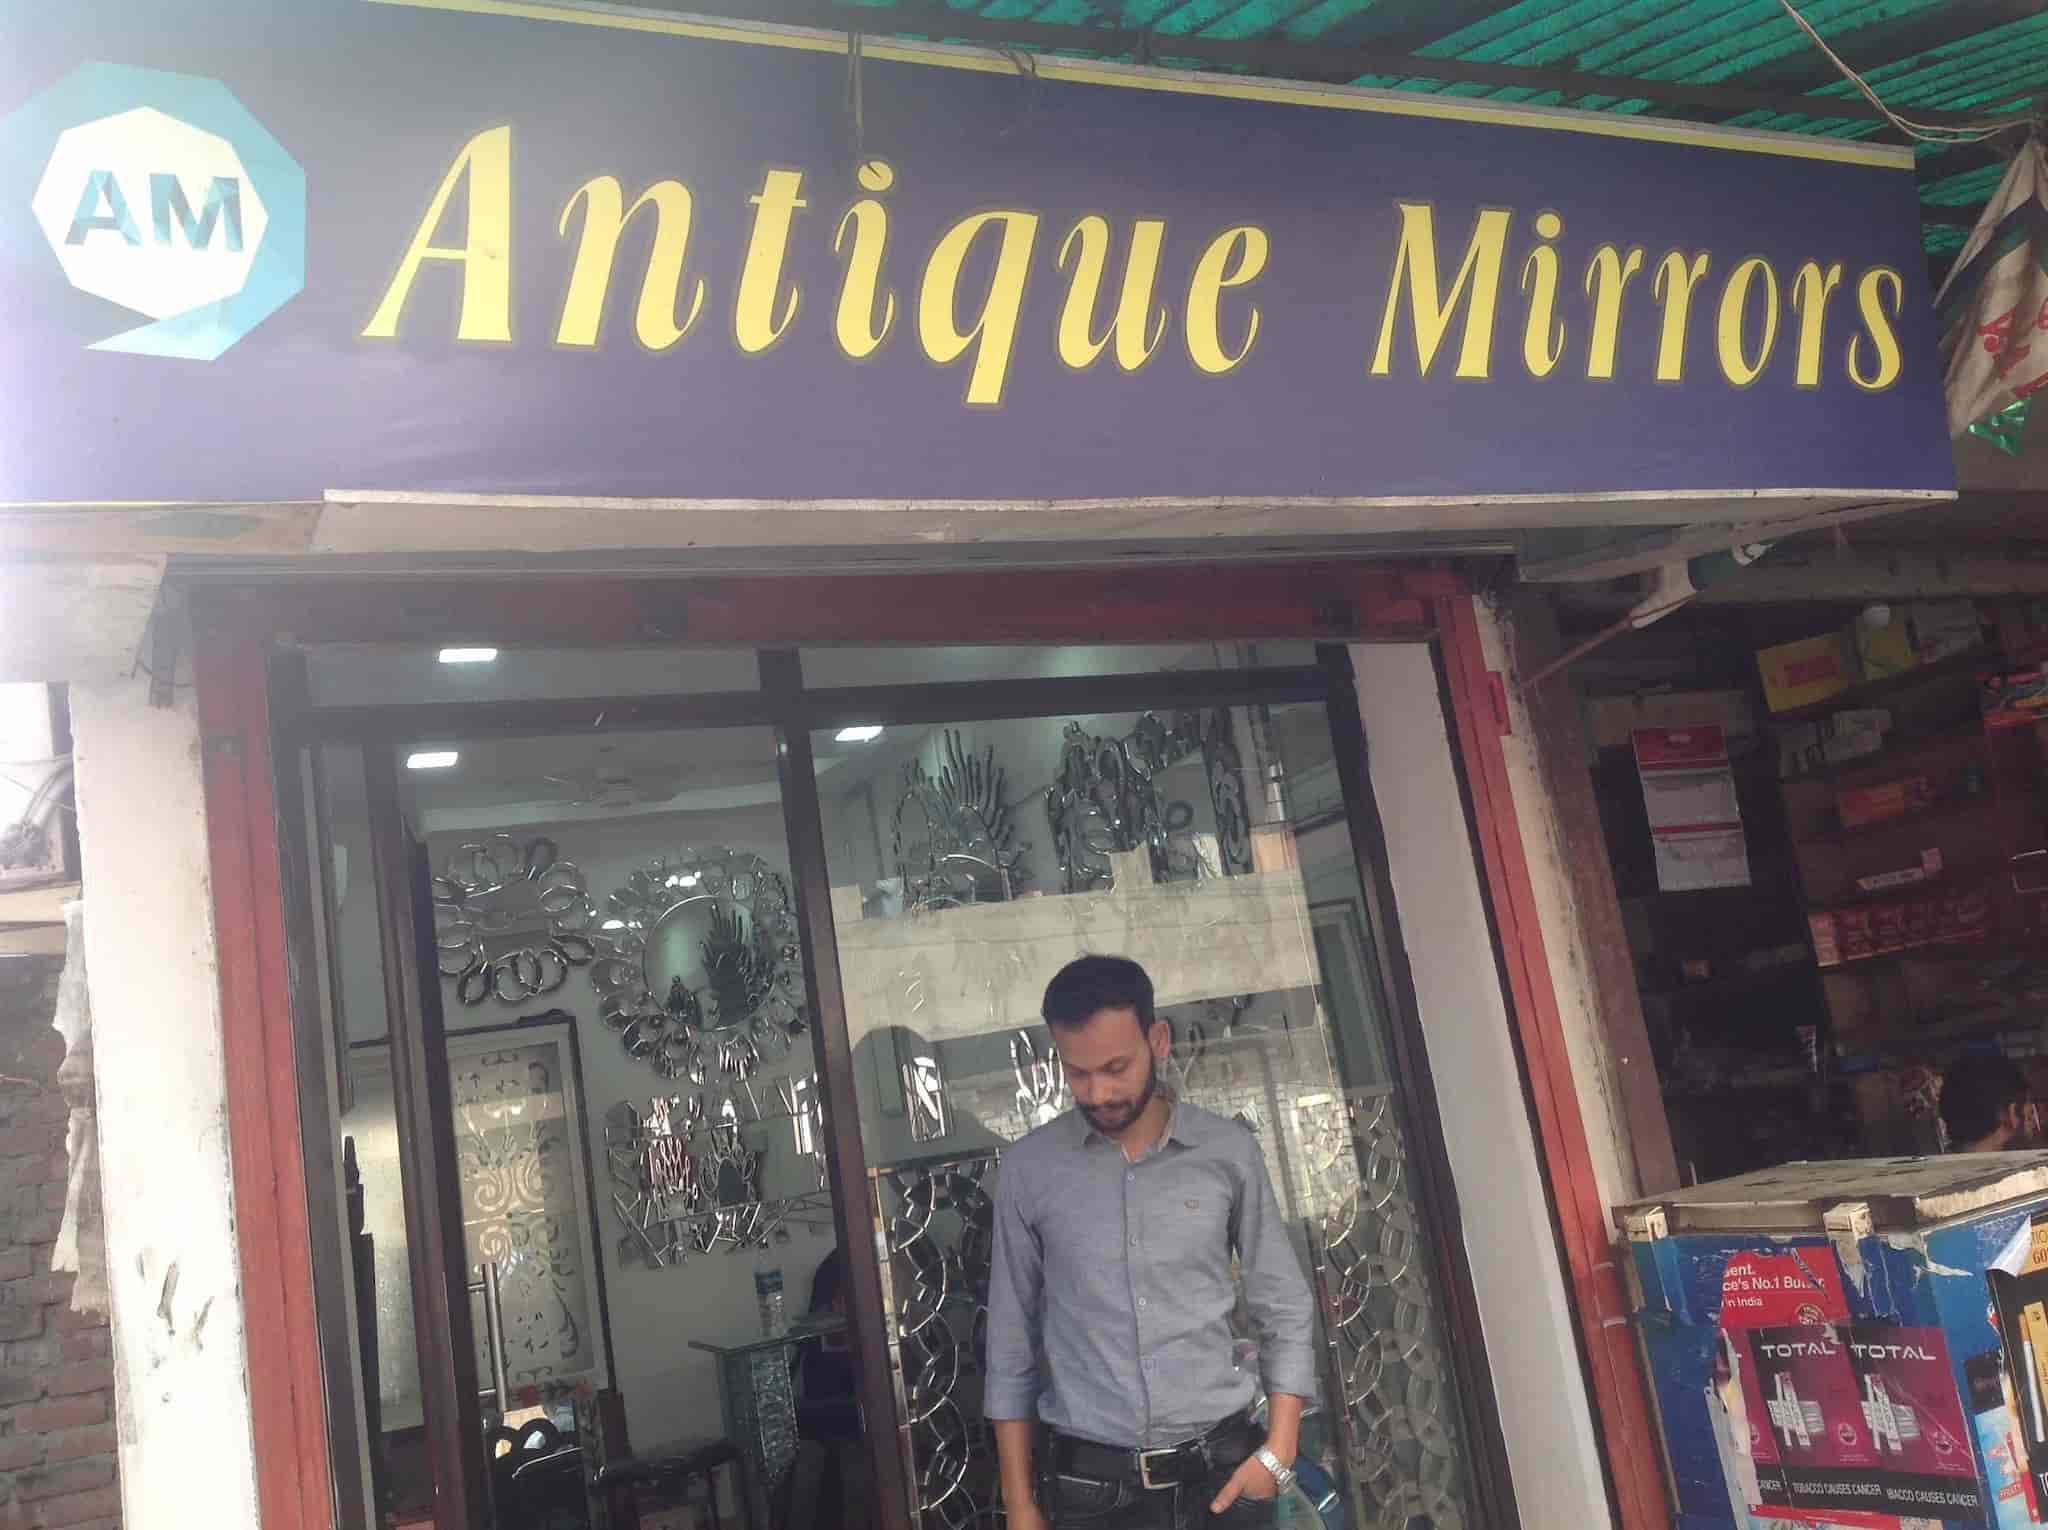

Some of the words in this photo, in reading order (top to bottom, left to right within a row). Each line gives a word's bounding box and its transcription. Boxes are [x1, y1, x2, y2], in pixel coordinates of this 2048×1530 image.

[64, 169, 245, 253] AM
[359, 125, 1269, 404] Antique
[1368, 203, 1904, 389] Mirrors
[1752, 1275, 1780, 1290] No.1
[1737, 1296, 1763, 1307] India
[1760, 1341, 1836, 1360] TOTAL
[1850, 1344, 1937, 1361] TOTAL
